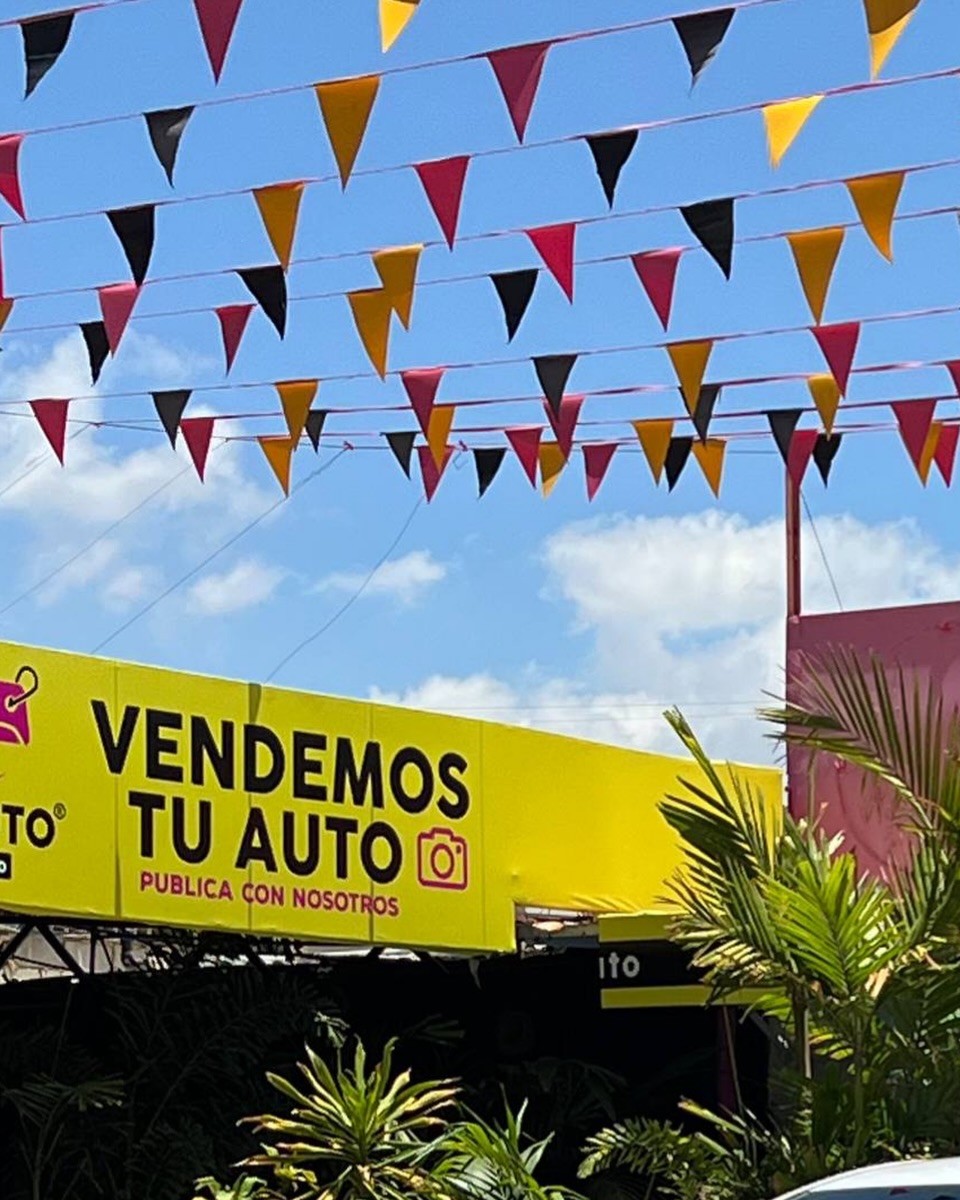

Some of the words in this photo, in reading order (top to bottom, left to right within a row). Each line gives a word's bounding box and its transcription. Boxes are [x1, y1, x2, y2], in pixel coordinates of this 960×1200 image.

[91, 699, 470, 819] VENDEMOS
[128, 791, 213, 864] TU
[235, 807, 403, 884] AUTO
[140, 871, 233, 901] PUBLICA
[242, 882, 284, 906] CON
[293, 888, 399, 917] NOSOTROS
